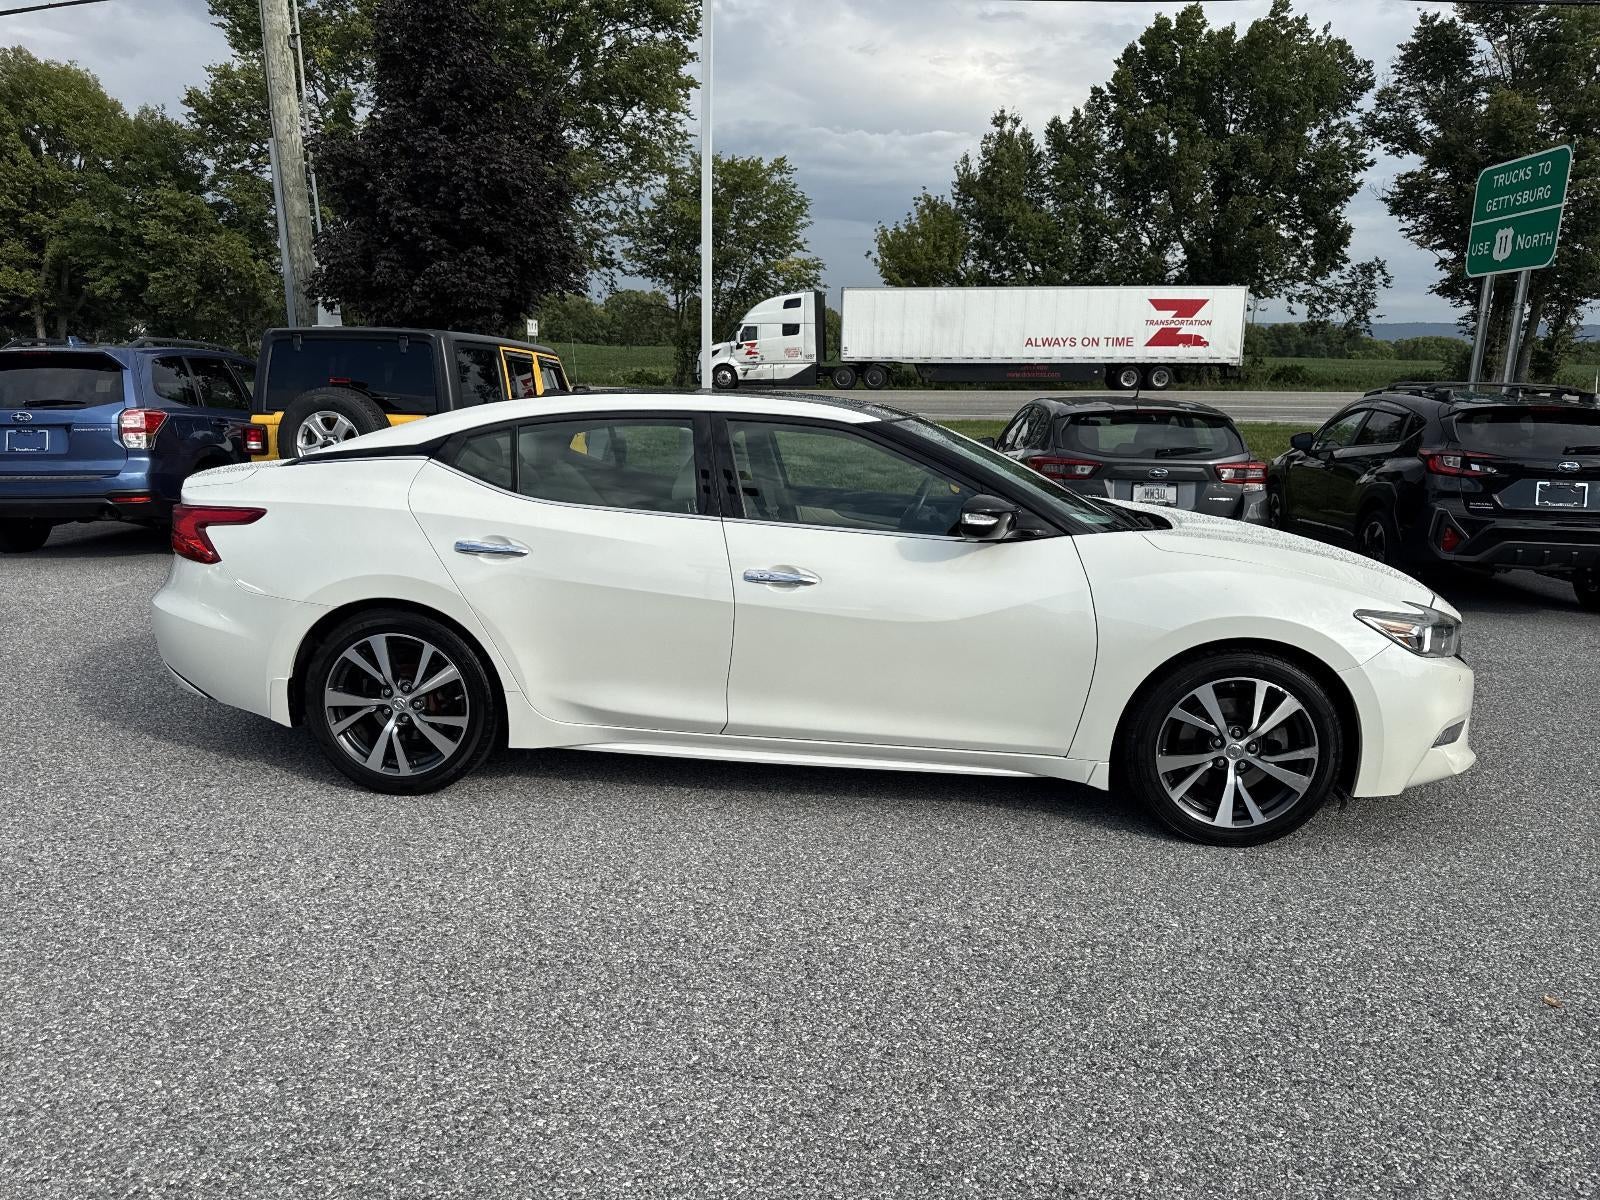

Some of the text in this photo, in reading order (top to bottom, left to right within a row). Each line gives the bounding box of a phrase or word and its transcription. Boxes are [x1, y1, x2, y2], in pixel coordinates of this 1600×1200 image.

[1493, 160, 1552, 189] TRUCKS TO
[1486, 185, 1552, 212] GETTYSBURG
[1471, 231, 1554, 257] USE 11 NORTH
[1144, 319, 1212, 327] TRANSPORTATION
[1025, 337, 1134, 347] ALWAYS ON TIME
